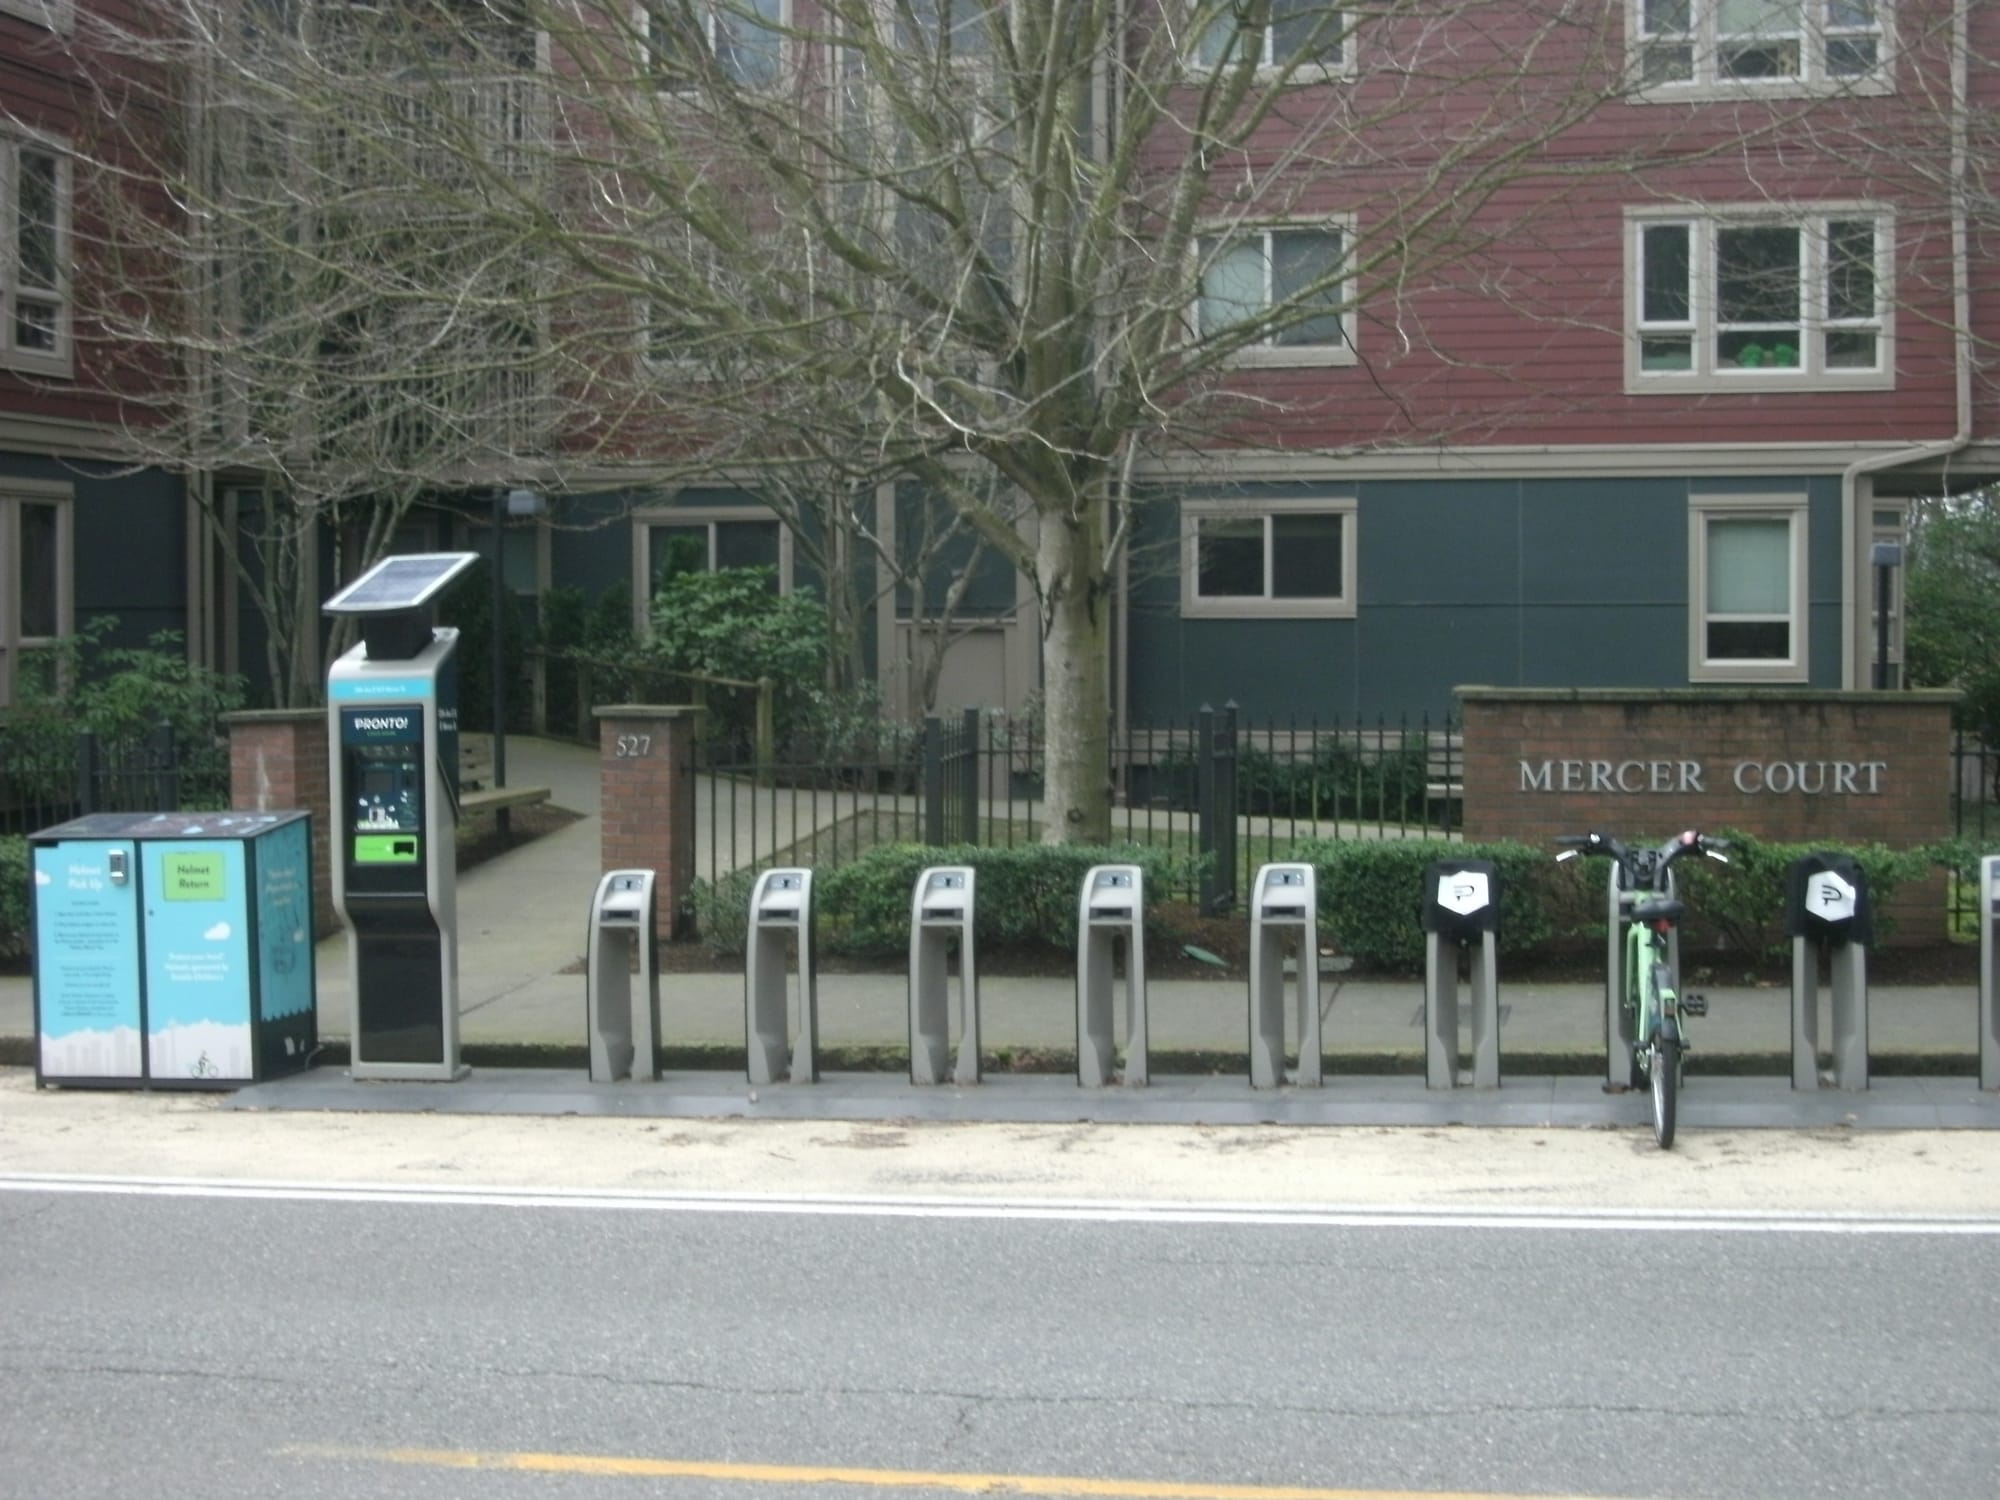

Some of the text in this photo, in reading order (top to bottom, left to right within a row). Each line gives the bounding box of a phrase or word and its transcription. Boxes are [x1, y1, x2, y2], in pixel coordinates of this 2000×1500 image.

[354, 716, 408, 730] PRONTO!
[616, 735, 650, 757] 527
[1518, 759, 1887, 794] MERCER COURT
[177, 864, 210, 875] Helmet
[178, 878, 210, 889] Return
